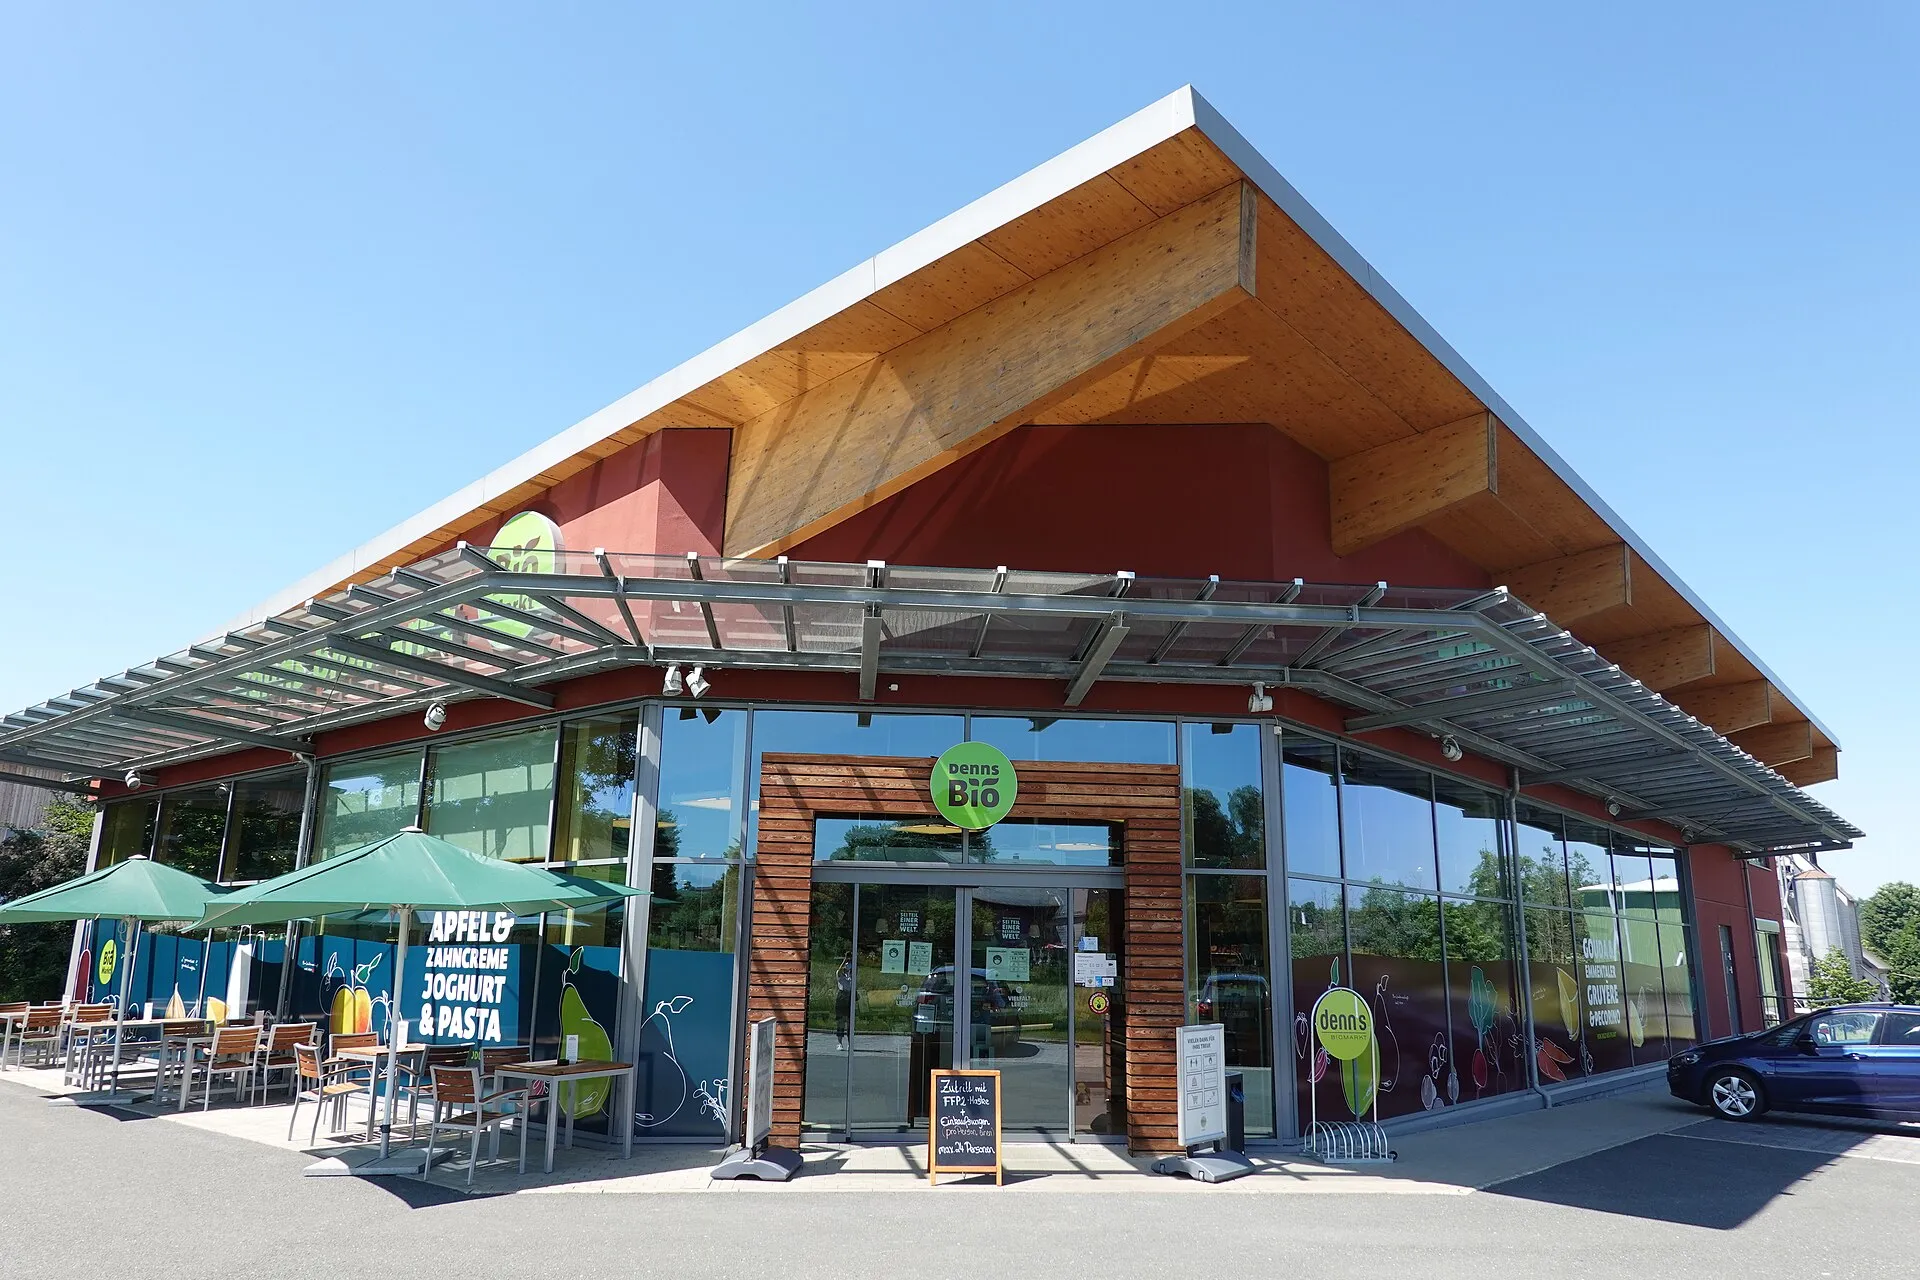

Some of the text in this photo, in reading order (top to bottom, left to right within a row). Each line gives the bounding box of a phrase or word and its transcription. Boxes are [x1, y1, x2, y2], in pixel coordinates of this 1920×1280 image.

[948, 778, 1000, 808] Bio
[1001, 932, 1021, 940] WELT.
[425, 947, 509, 970] ZAHNCREME
[421, 972, 507, 1004] JOGHURT
[1587, 980, 1619, 1006] GRUYÈRE
[419, 1002, 502, 1043] & PASTA
[940, 1115, 991, 1129] Einkaufswagen
[964, 1140, 996, 1154] Personen
